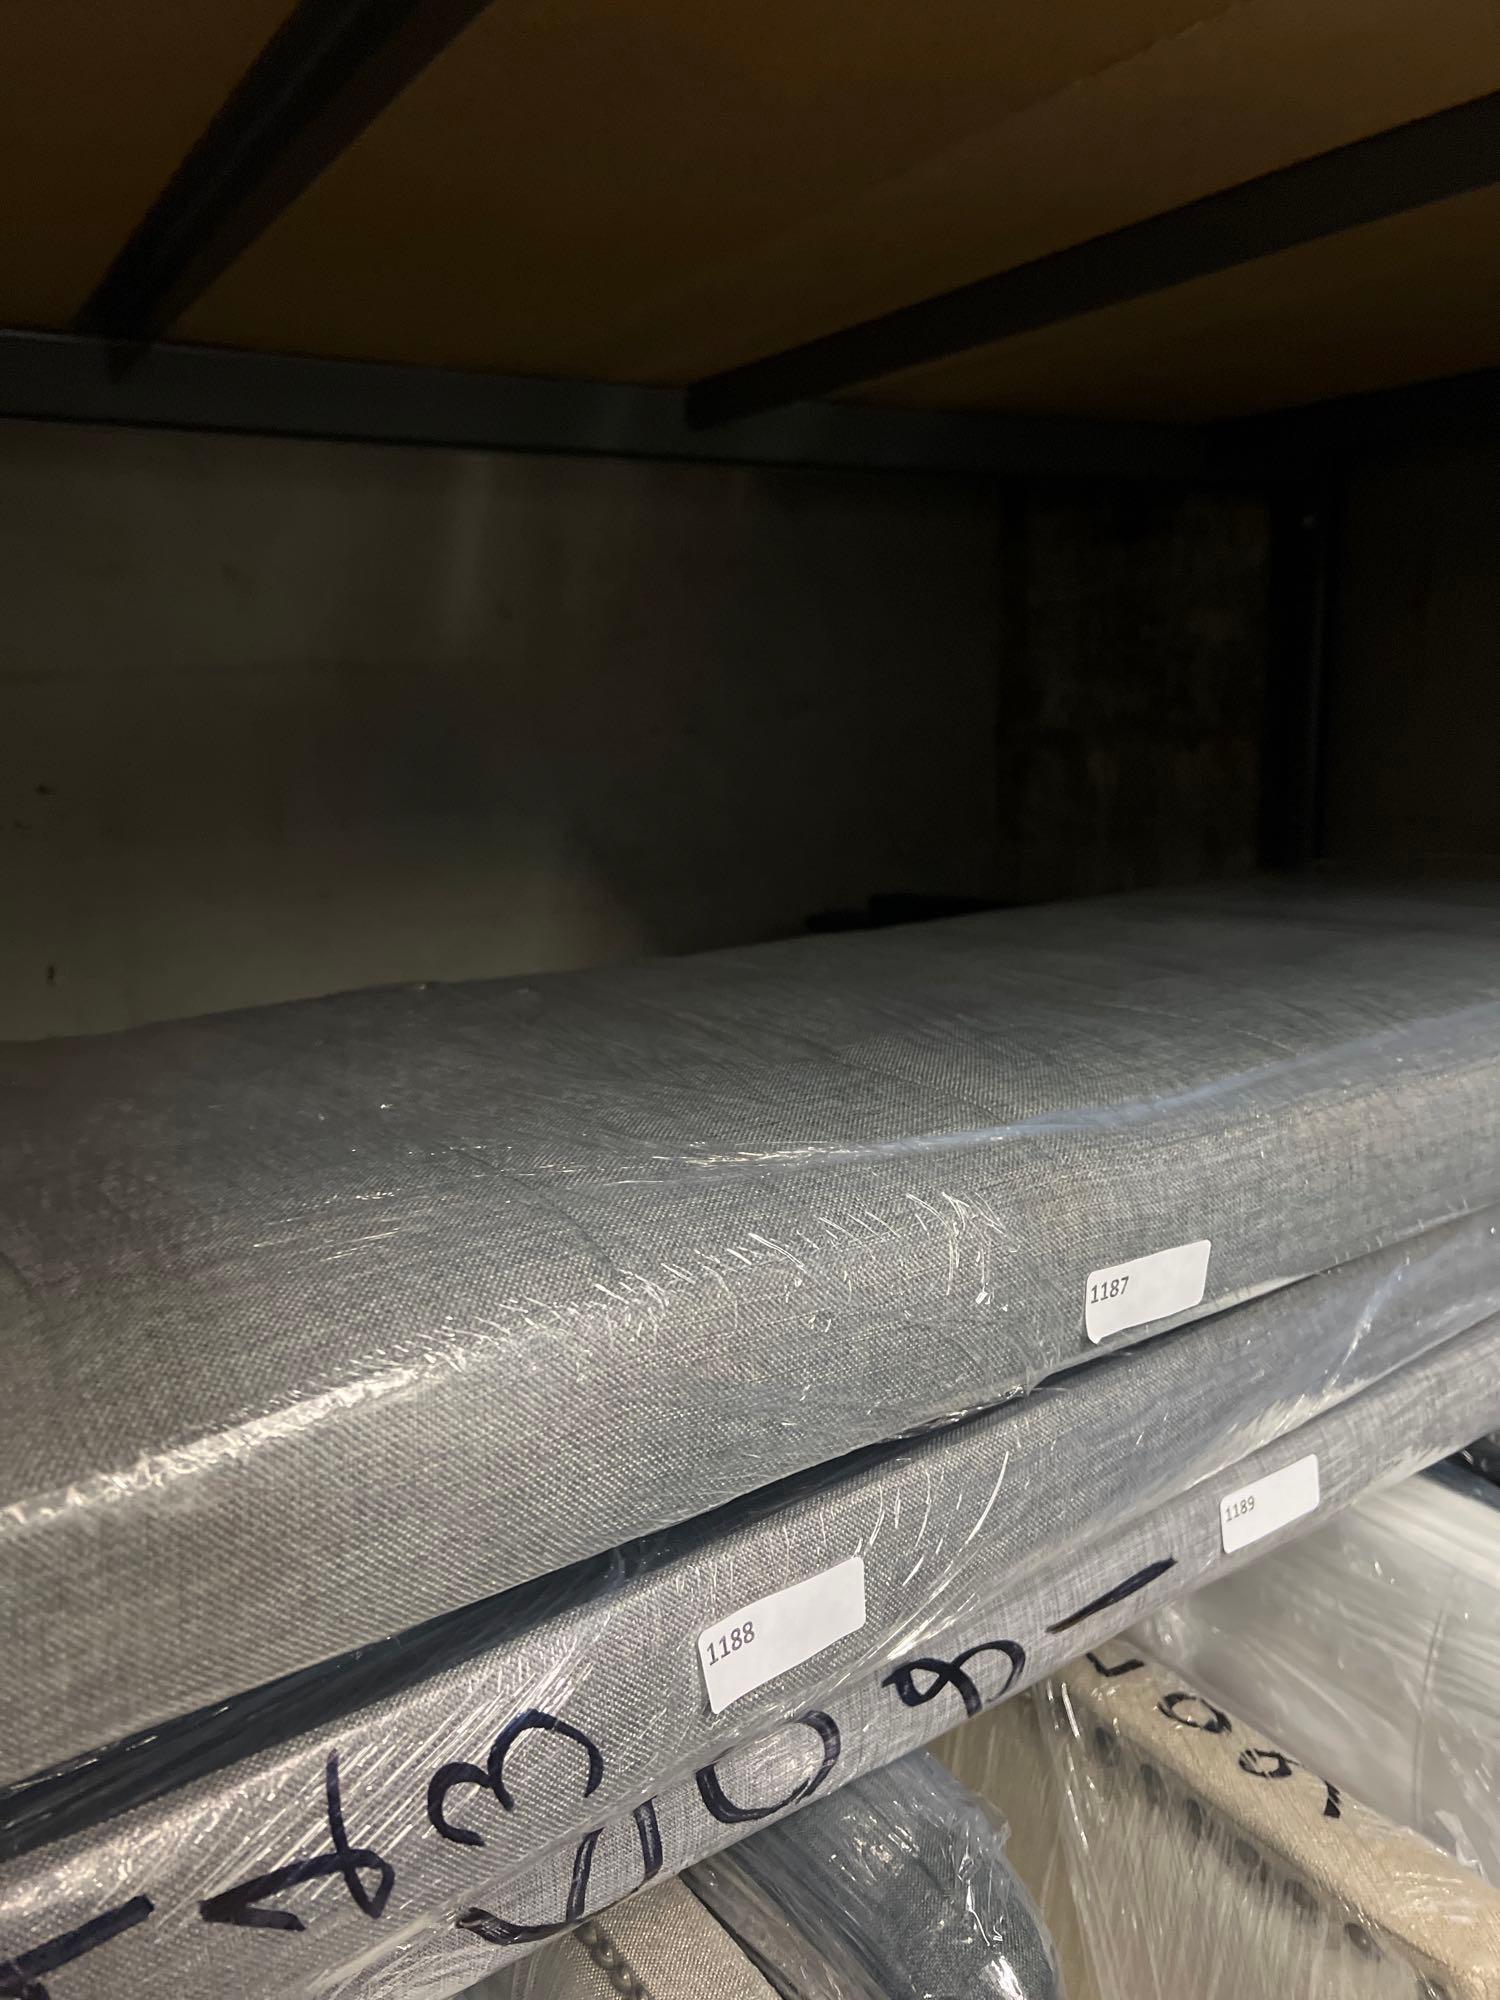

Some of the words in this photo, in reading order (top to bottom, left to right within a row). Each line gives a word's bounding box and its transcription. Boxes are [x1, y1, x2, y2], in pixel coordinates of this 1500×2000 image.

[1090, 1276, 1130, 1304] 1187
[1225, 1495, 1255, 1523] 1189
[706, 1621, 756, 1667] 1188
